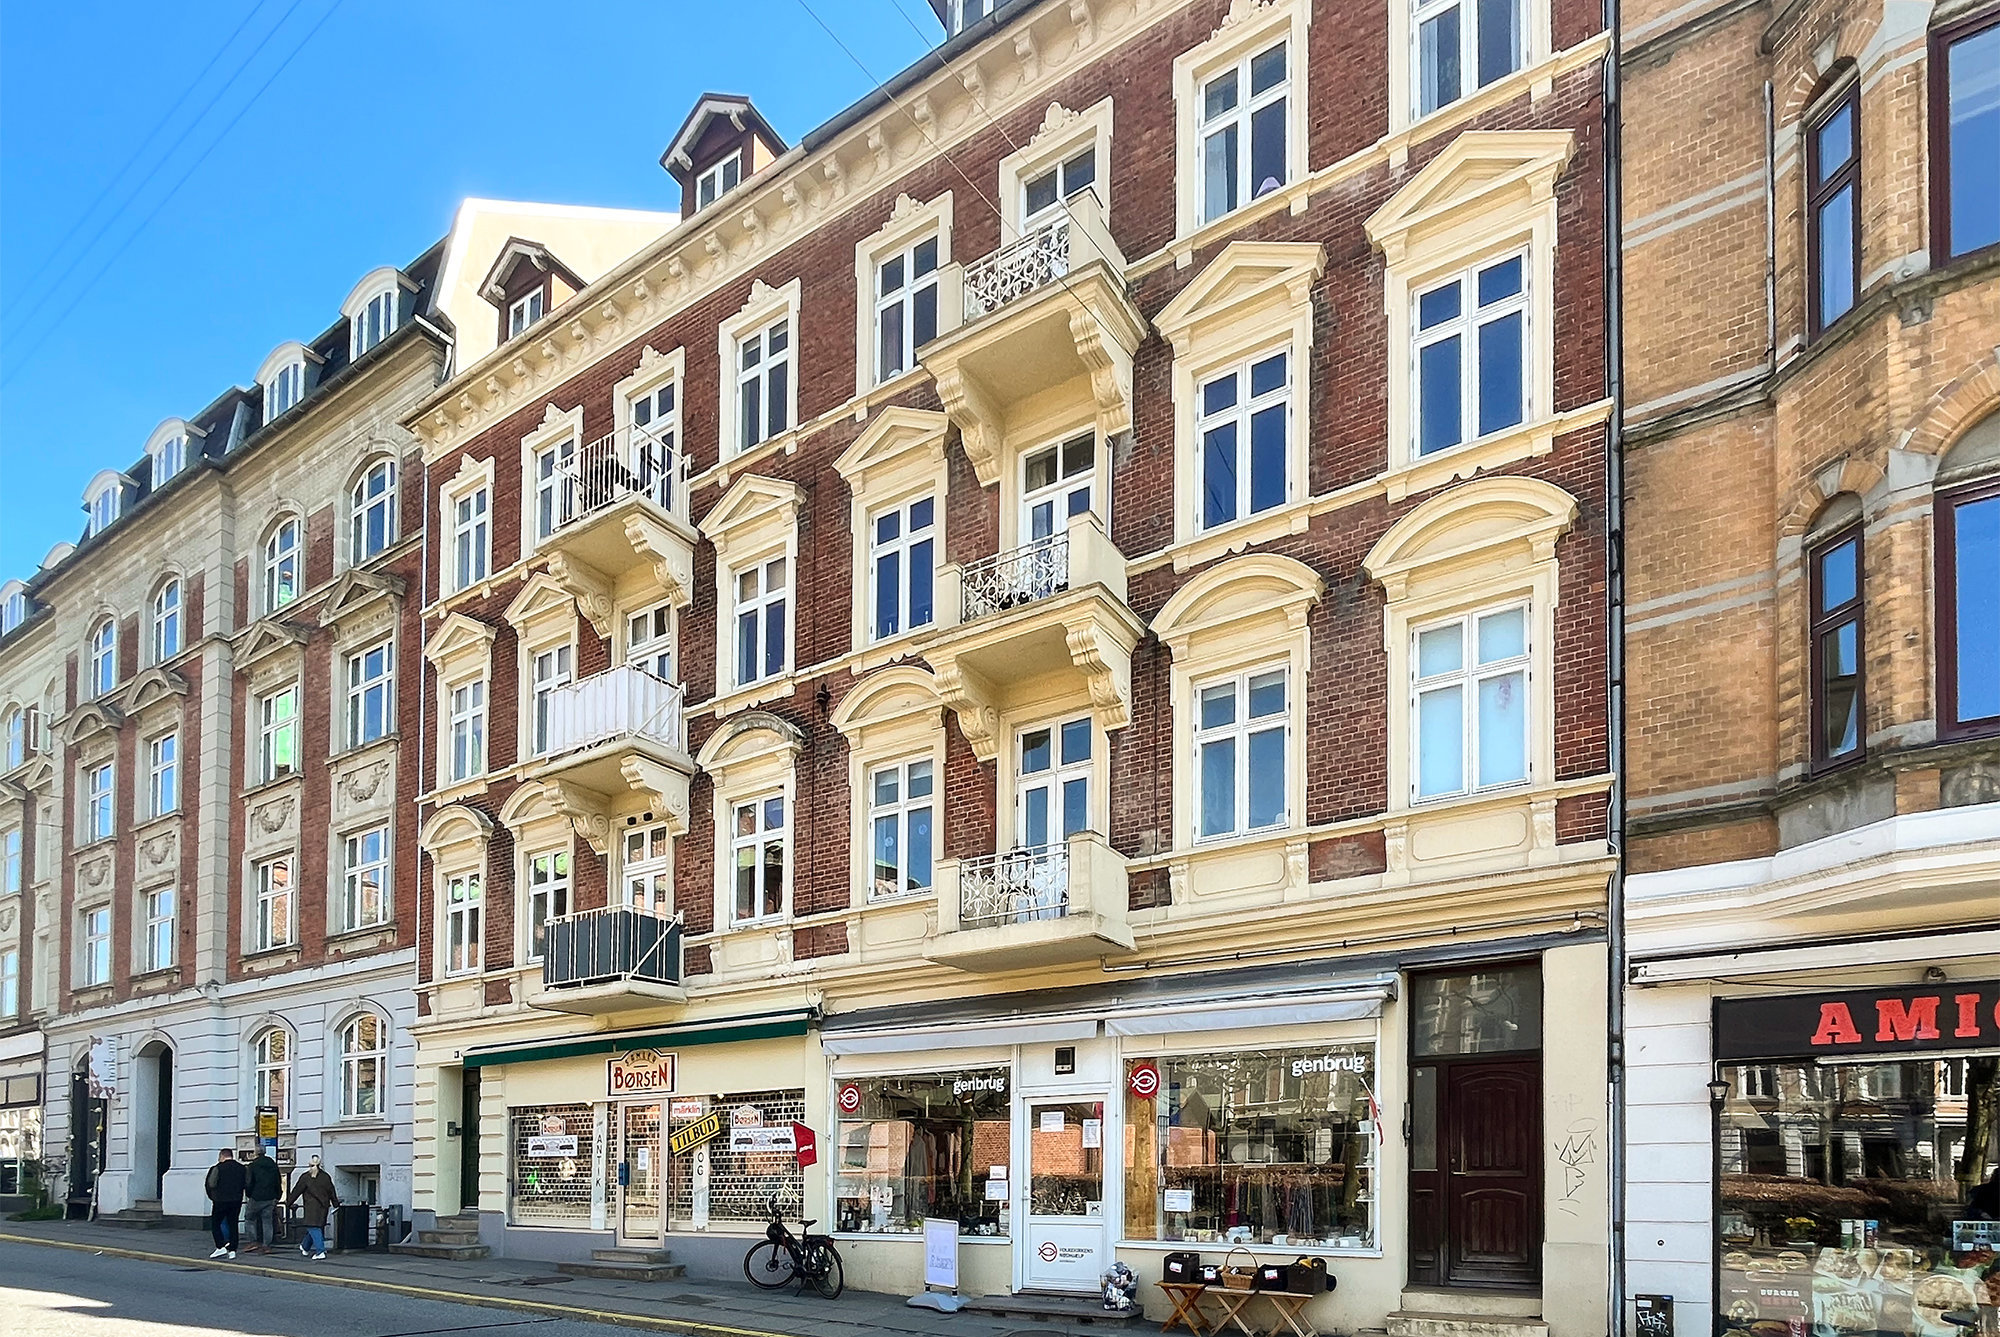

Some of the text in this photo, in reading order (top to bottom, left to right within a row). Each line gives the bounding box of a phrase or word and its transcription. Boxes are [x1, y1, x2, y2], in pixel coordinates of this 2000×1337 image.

[1811, 993, 2000, 1045] AMI
[614, 1062, 668, 1089] BØRSEN
[1291, 1054, 1366, 1077] genbrug
[953, 1076, 1005, 1095] genbrug
[675, 1118, 716, 1150] TILBUD
